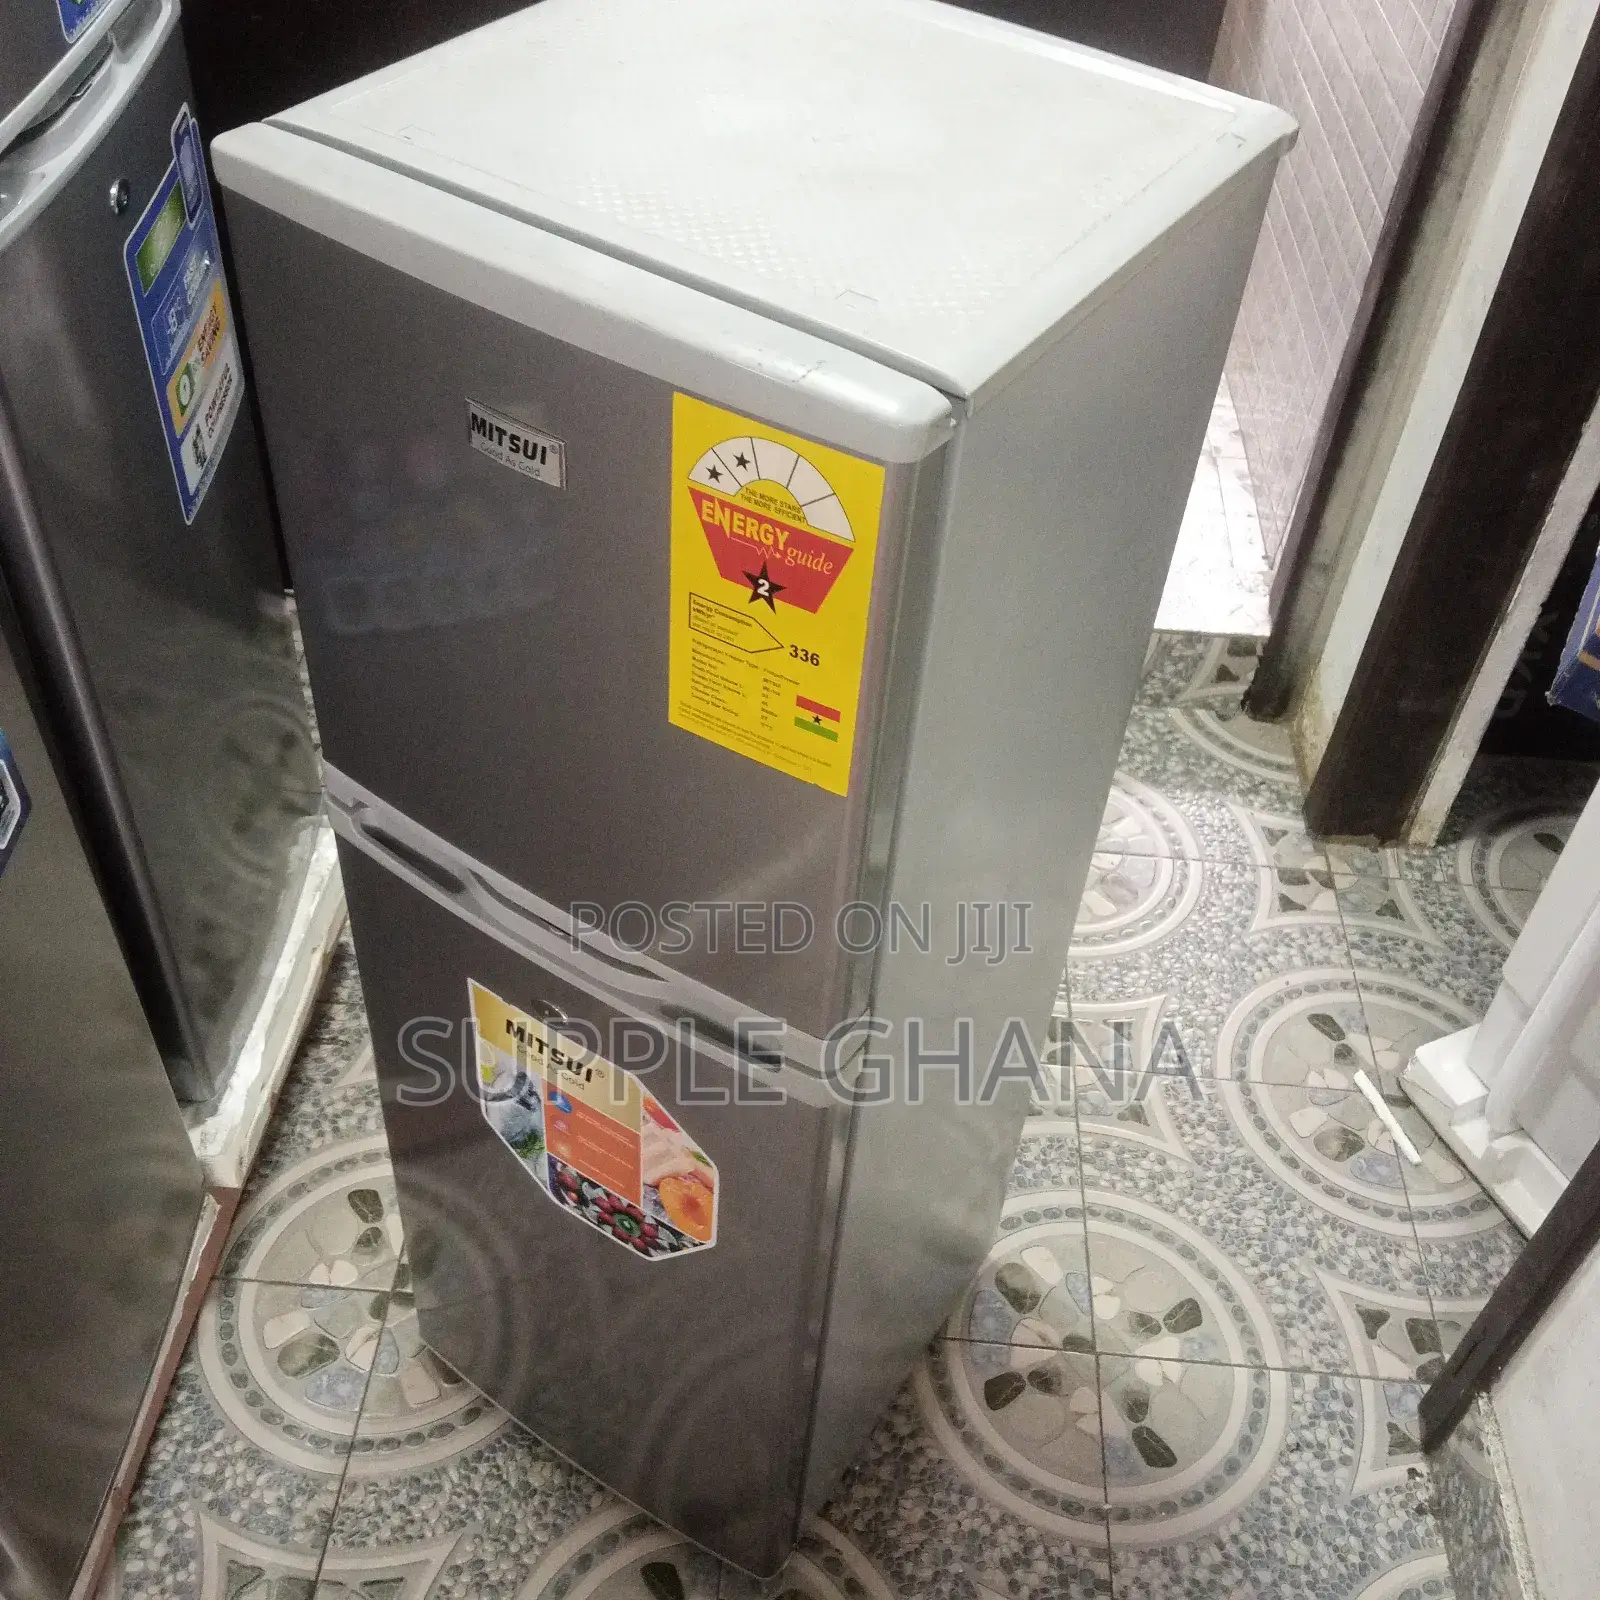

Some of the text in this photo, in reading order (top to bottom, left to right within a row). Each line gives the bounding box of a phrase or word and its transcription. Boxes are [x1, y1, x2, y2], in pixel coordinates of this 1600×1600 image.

[470, 411, 547, 466] MITSUI
[740, 493, 806, 524] THE MORE EFFICIENT
[745, 487, 802, 513] THE MORE STARS
[701, 497, 833, 575] ENERGY guide
[757, 578, 769, 597] 2
[788, 644, 820, 667] 336
[506, 1018, 593, 1083] MITSUI
